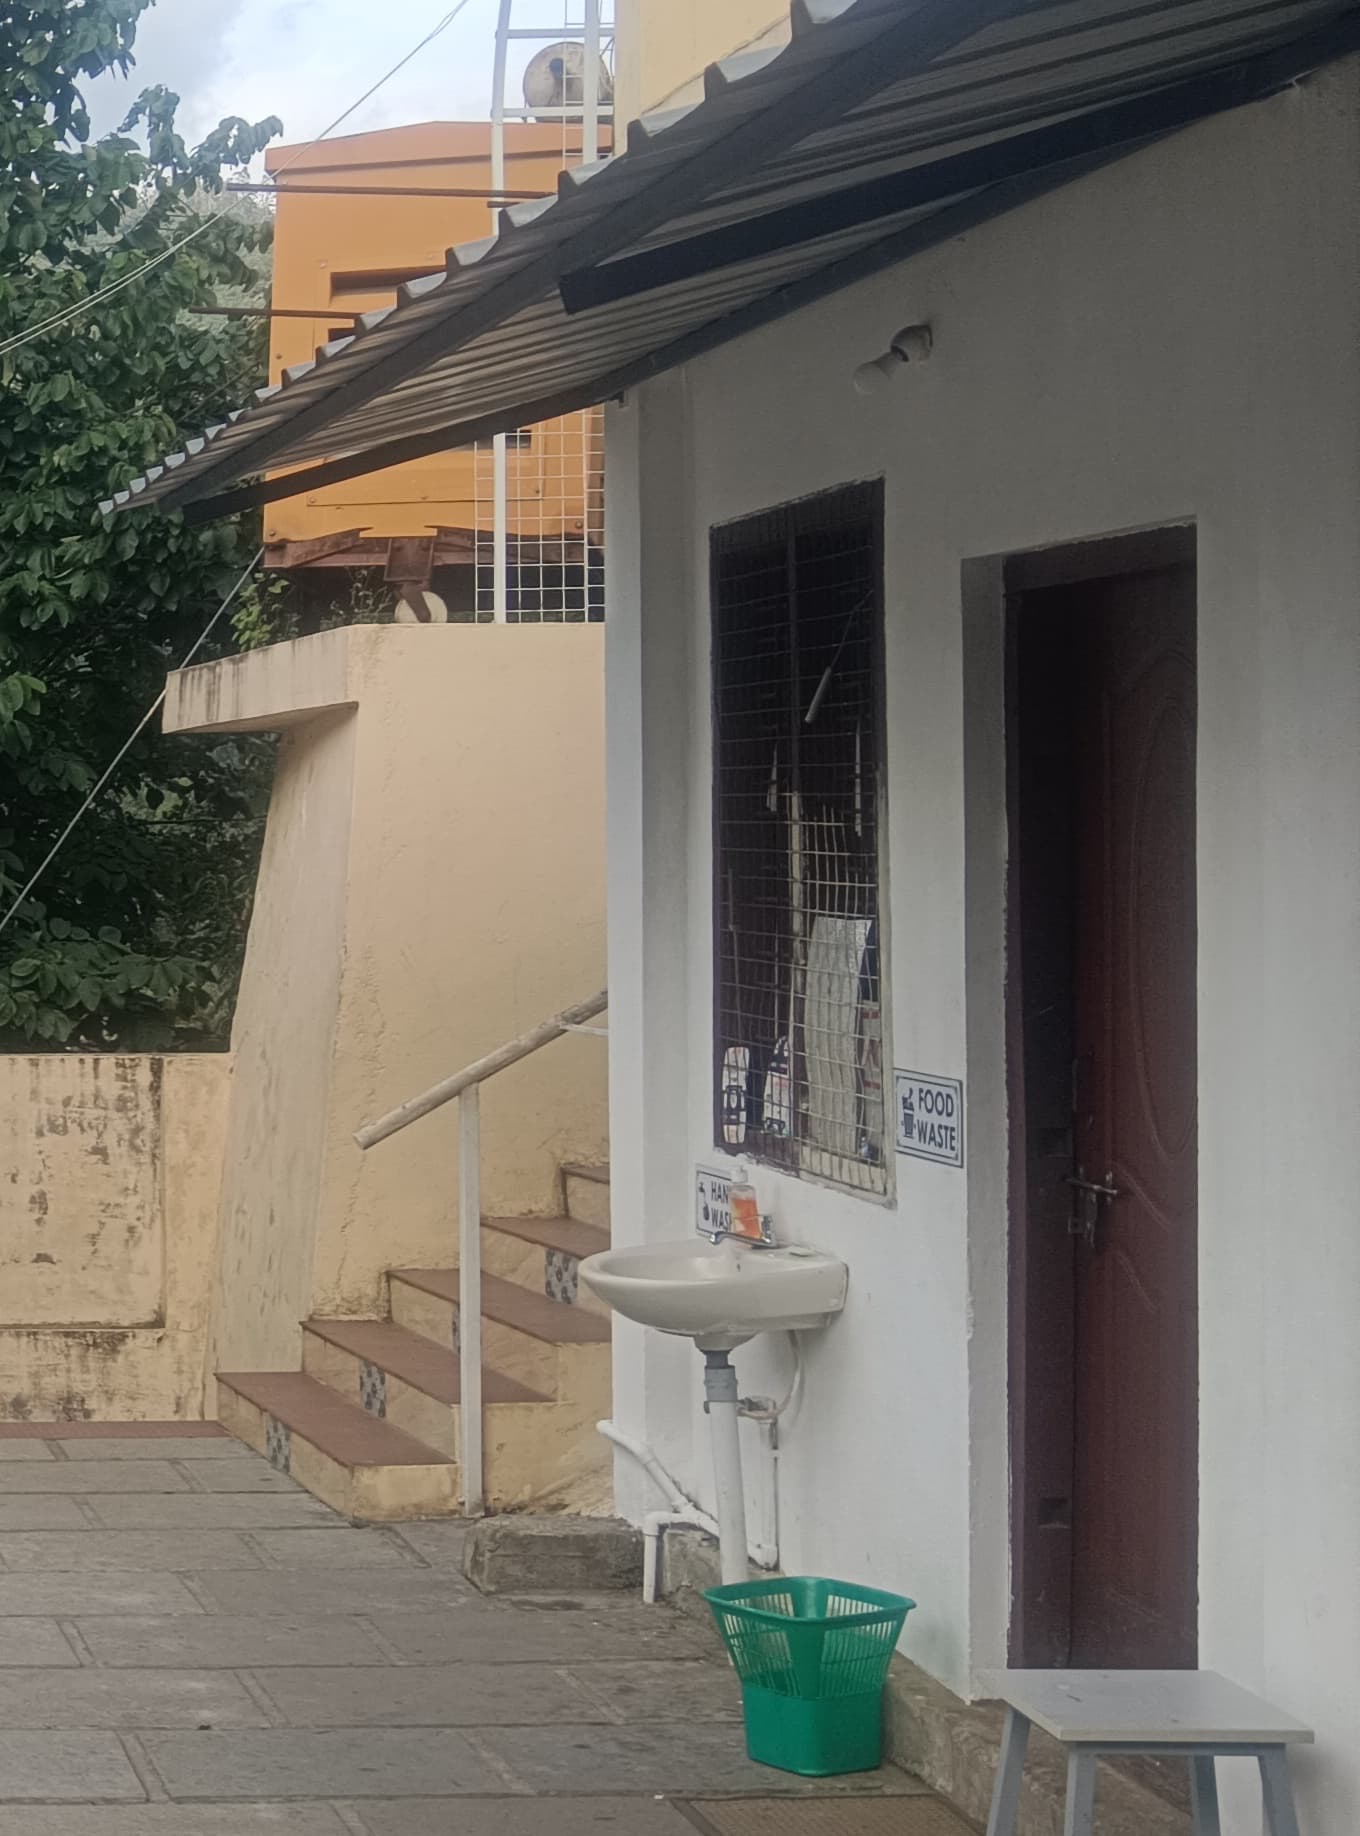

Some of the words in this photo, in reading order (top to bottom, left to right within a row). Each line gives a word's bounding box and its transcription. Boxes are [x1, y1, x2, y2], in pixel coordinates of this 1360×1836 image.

[918, 1087, 954, 1117] FOOD
[917, 1119, 956, 1151] WASTE
[711, 1180, 729, 1204] HAN
